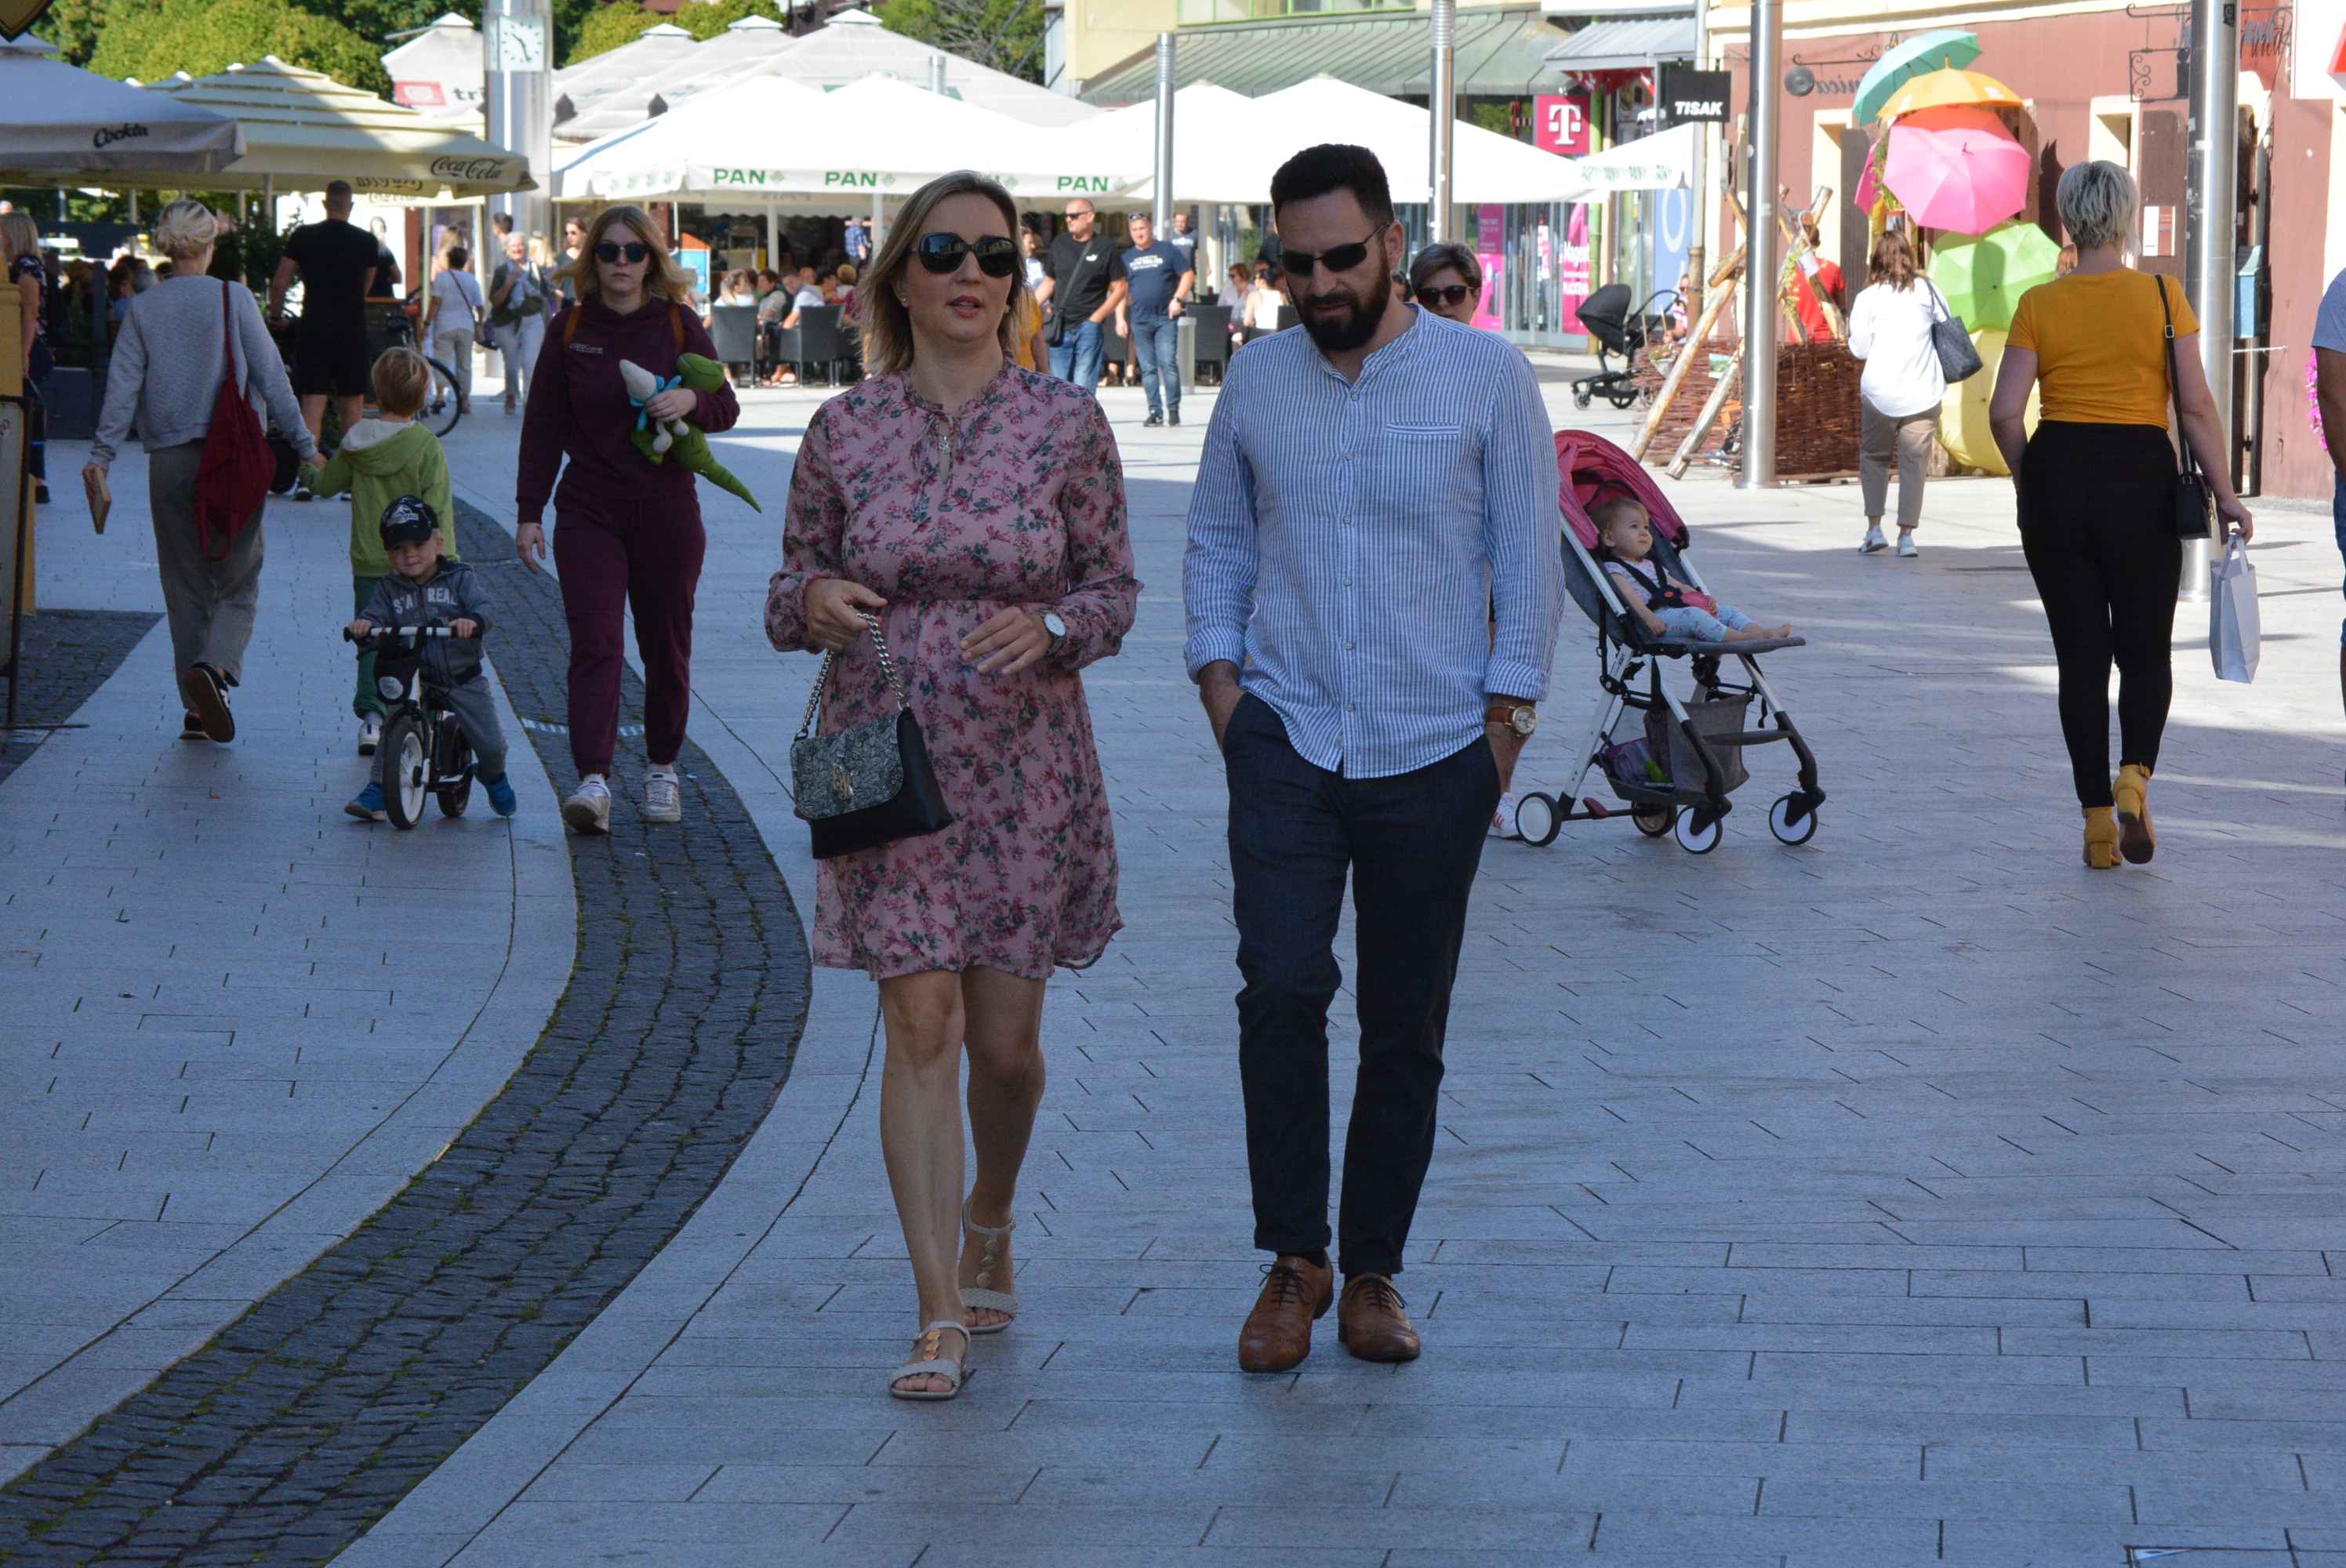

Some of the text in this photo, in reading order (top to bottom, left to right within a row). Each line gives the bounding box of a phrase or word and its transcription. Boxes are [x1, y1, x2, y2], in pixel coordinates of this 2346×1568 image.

[1675, 101, 1723, 116] TISAK
[1548, 104, 1582, 145] T
[714, 169, 766, 184] PAN
[824, 172, 877, 187] PAN
[1056, 176, 1109, 192] PAN
[393, 587, 457, 615] SA REAL
